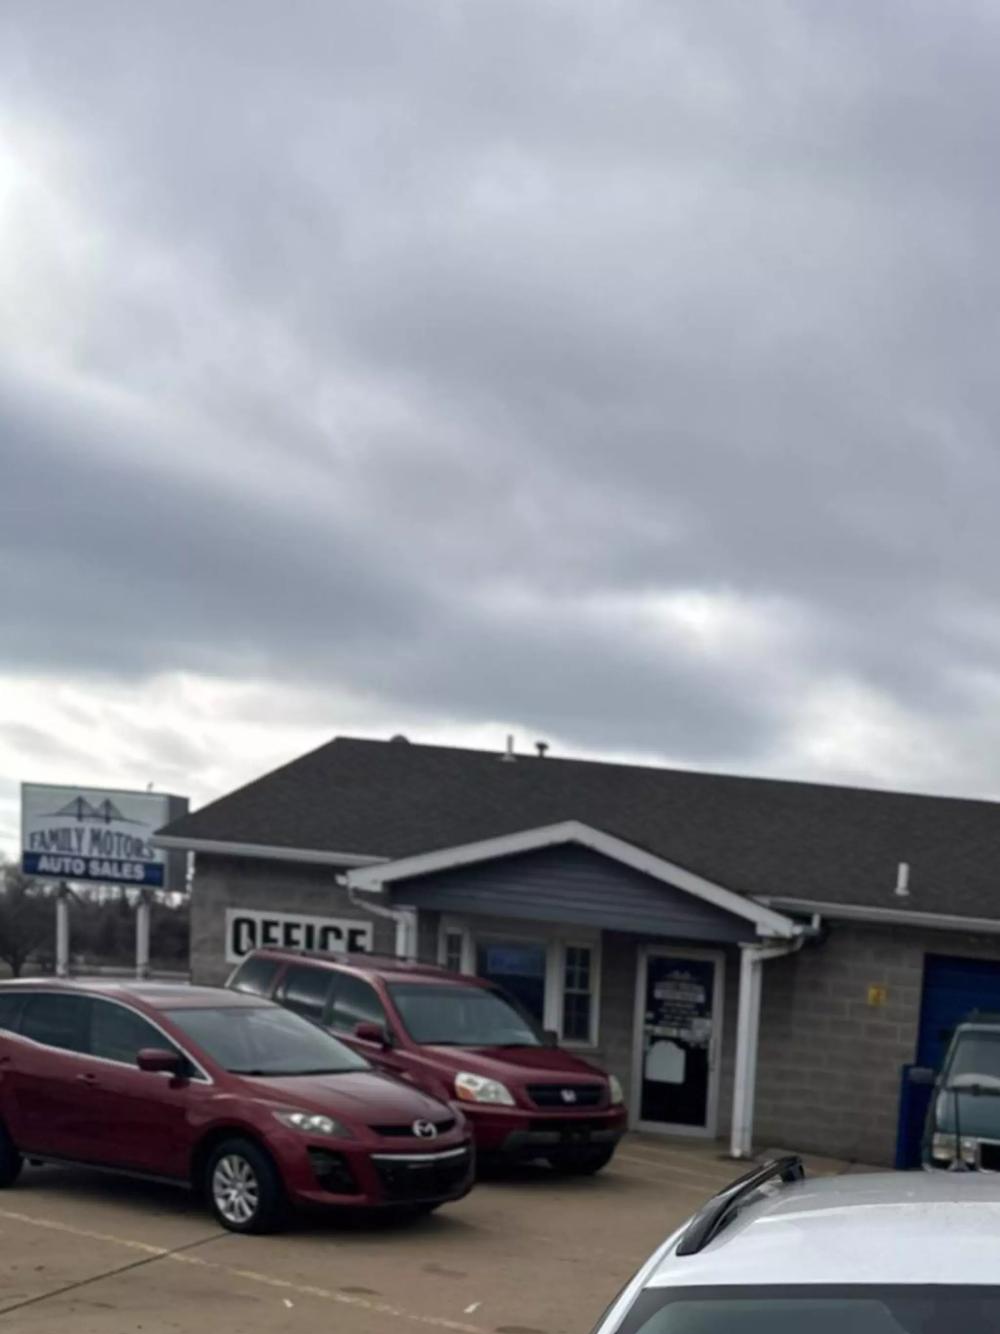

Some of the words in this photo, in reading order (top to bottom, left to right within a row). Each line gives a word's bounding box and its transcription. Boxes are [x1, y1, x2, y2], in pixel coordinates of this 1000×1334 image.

[29, 827, 85, 855] FAMILY
[87, 828, 155, 860] MOTORS
[38, 855, 85, 875] AUTO
[88, 860, 145, 881] SALES
[232, 917, 367, 956] OFFICE
